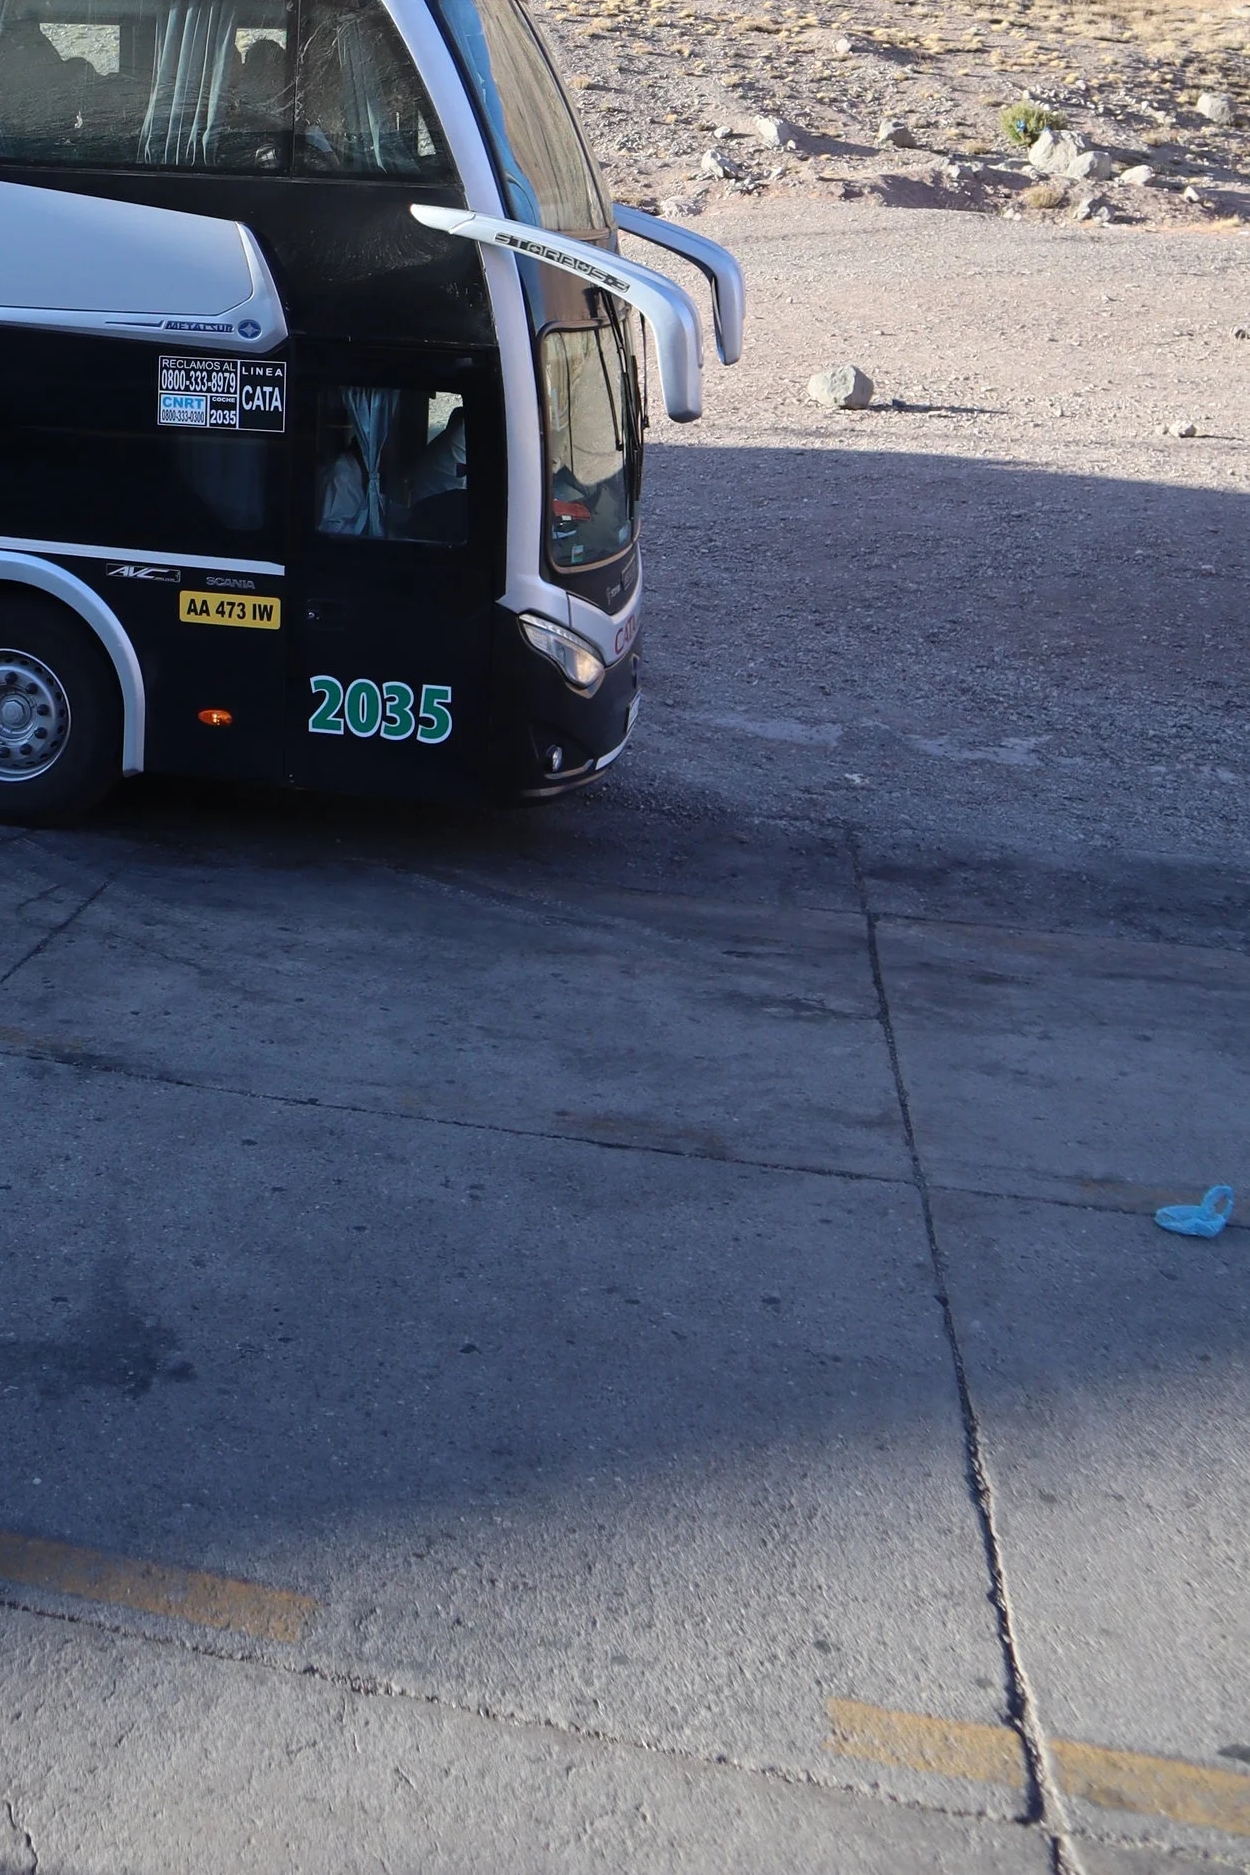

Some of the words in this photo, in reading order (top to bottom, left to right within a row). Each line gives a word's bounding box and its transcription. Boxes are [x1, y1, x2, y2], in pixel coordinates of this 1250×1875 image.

[162, 359, 221, 371] RECLAMOS
[222, 363, 236, 371] AL
[242, 366, 283, 377] LINEA
[161, 369, 236, 393] 0800-333-8979
[162, 396, 204, 409] CNRT
[241, 385, 283, 412] CATA
[210, 409, 236, 425] 2035
[206, 576, 255, 589] SCANIA
[186, 598, 211, 617] AA
[215, 602, 246, 619] 473
[252, 603, 274, 622] IW
[308, 675, 453, 744] 2035
